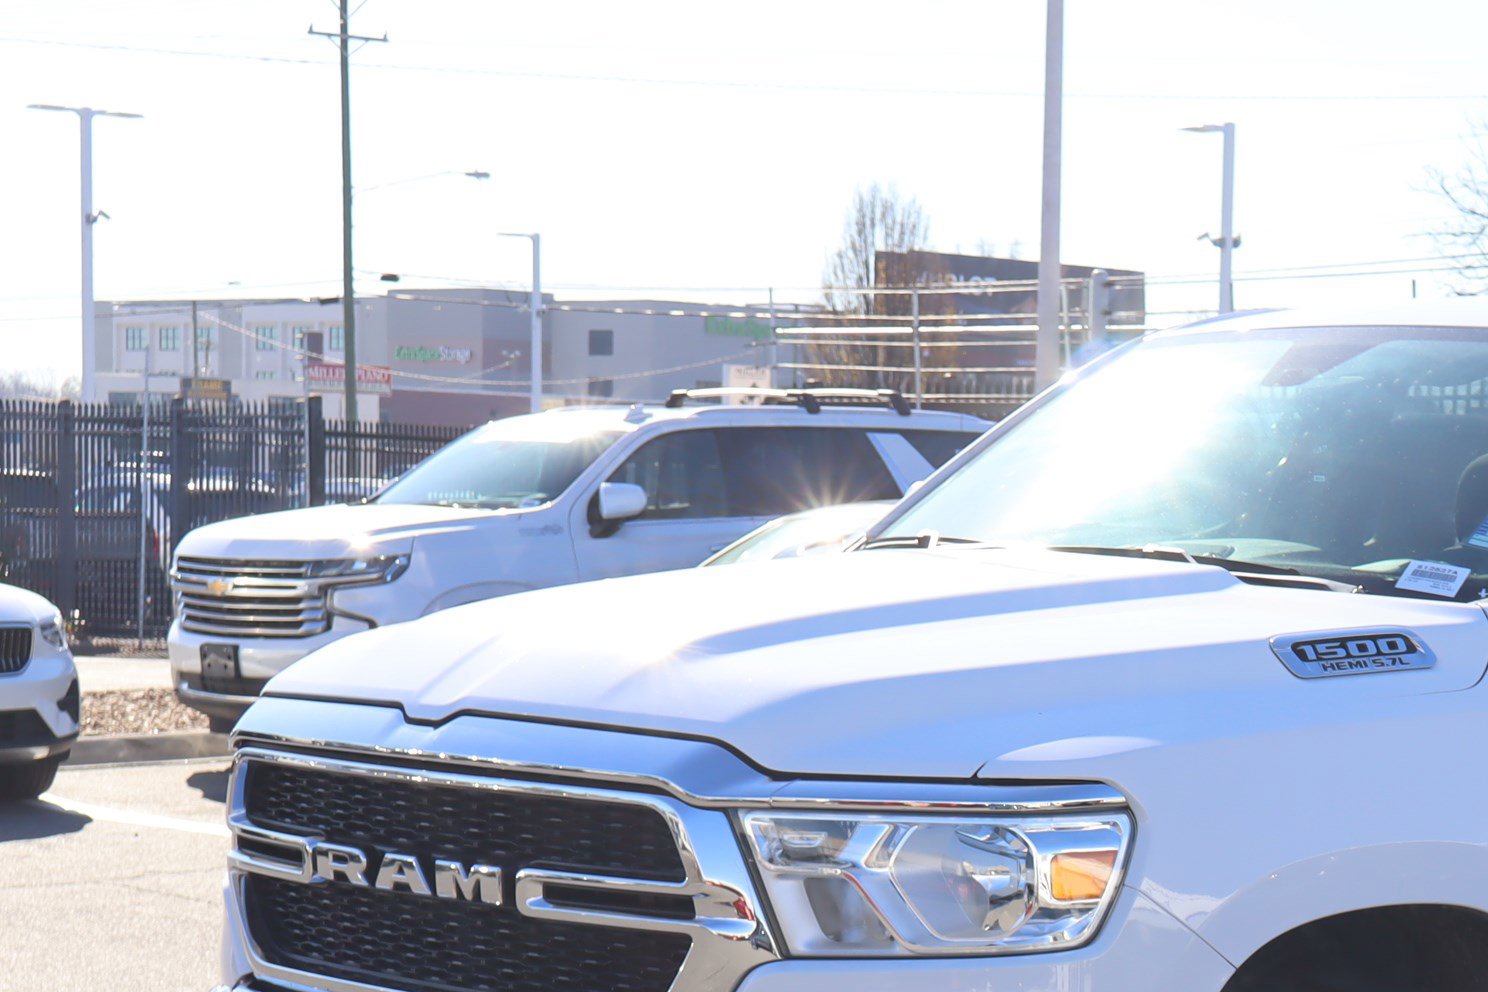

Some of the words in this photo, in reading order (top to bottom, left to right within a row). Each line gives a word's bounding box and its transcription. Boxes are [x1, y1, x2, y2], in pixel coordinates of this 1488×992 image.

[1297, 636, 1409, 661] 1500
[1321, 660, 1368, 672] HEMI
[1372, 656, 1410, 668] 5.7L
[314, 841, 503, 906] RAM
